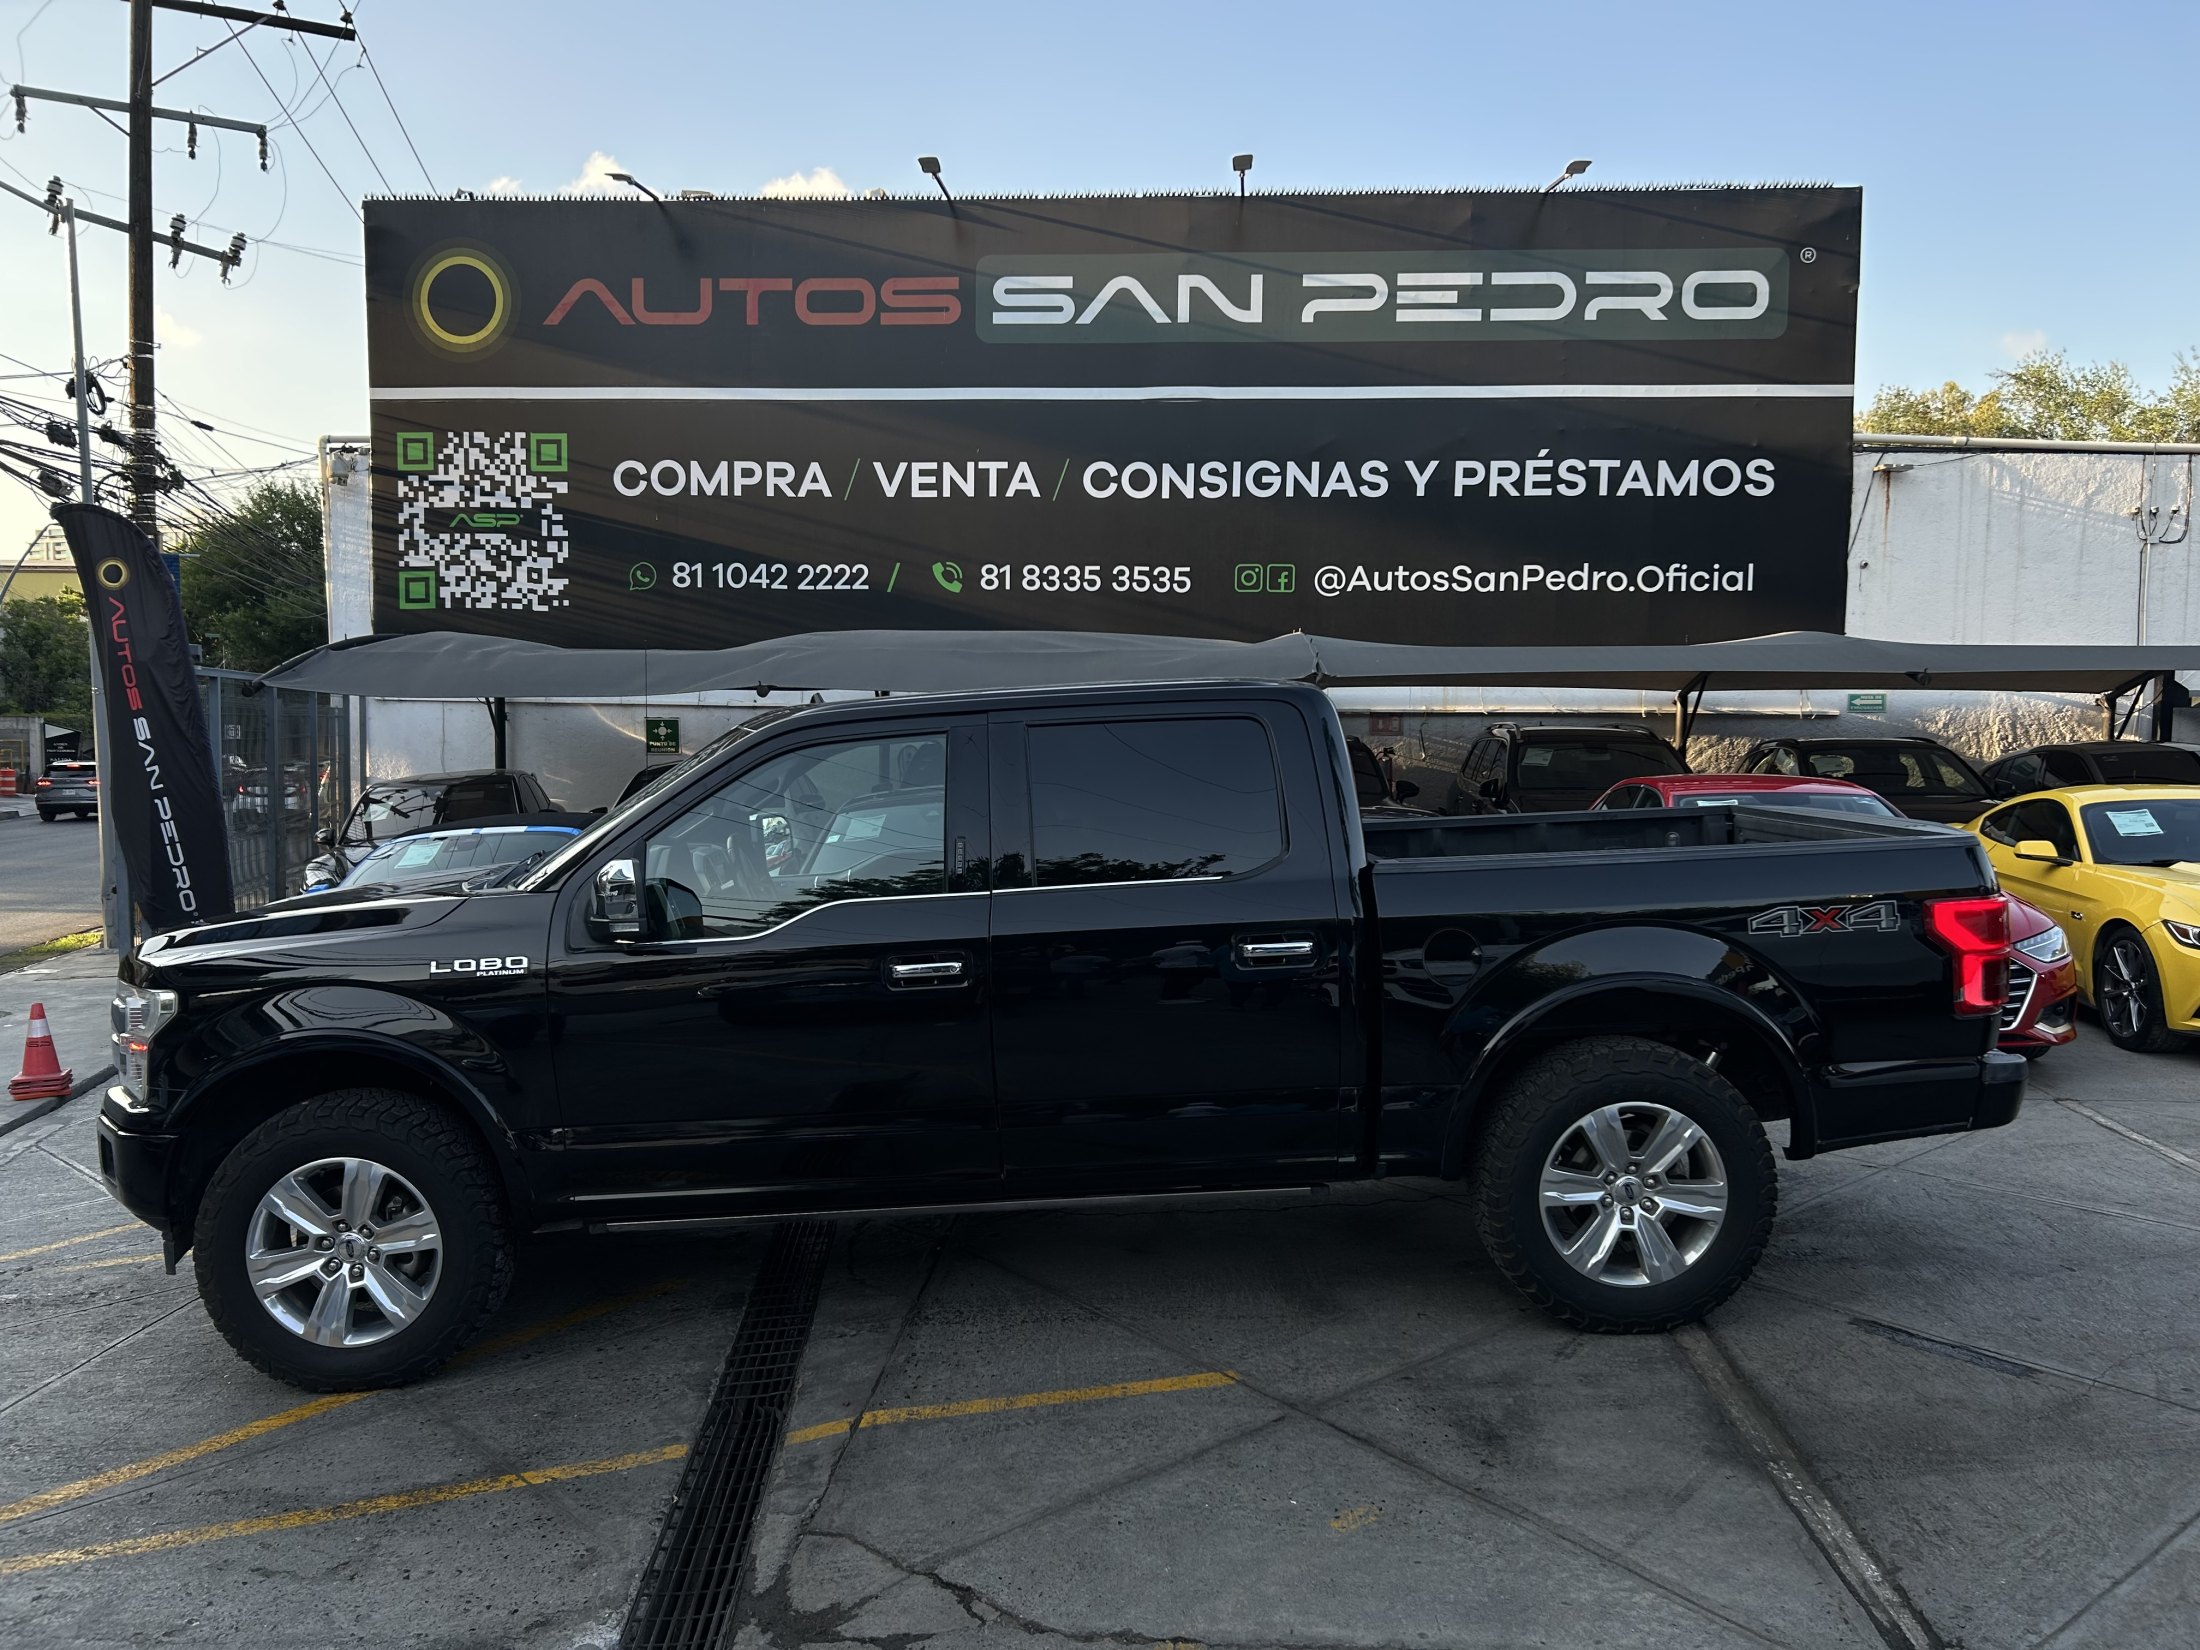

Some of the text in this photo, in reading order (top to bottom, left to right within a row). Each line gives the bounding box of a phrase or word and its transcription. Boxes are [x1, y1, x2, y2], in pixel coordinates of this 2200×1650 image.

[543, 277, 961, 326] AUTOS
[991, 273, 1264, 325] SAN
[1301, 269, 1771, 323] PEDRO
[613, 459, 833, 498] COMPRA
[872, 461, 1041, 498] VENTA
[1082, 459, 1389, 499] CONSIGNAS
[1404, 460, 1440, 497] Y
[1454, 447, 1775, 498] PRÉSTAMOS
[449, 513, 520, 527] ASP
[672, 561, 702, 588] 81
[712, 562, 788, 590] 1042
[797, 563, 869, 590] 2222
[980, 563, 1010, 591] 81
[1021, 564, 1102, 593] 8335
[1111, 565, 1191, 594] 3535
[1314, 562, 1754, 598] @AutosSanPedro.Oficial
[109, 596, 196, 912] AUTOS SAN PEDRO
[430, 956, 528, 973] LOBO
[476, 969, 525, 977] PLATINUM
